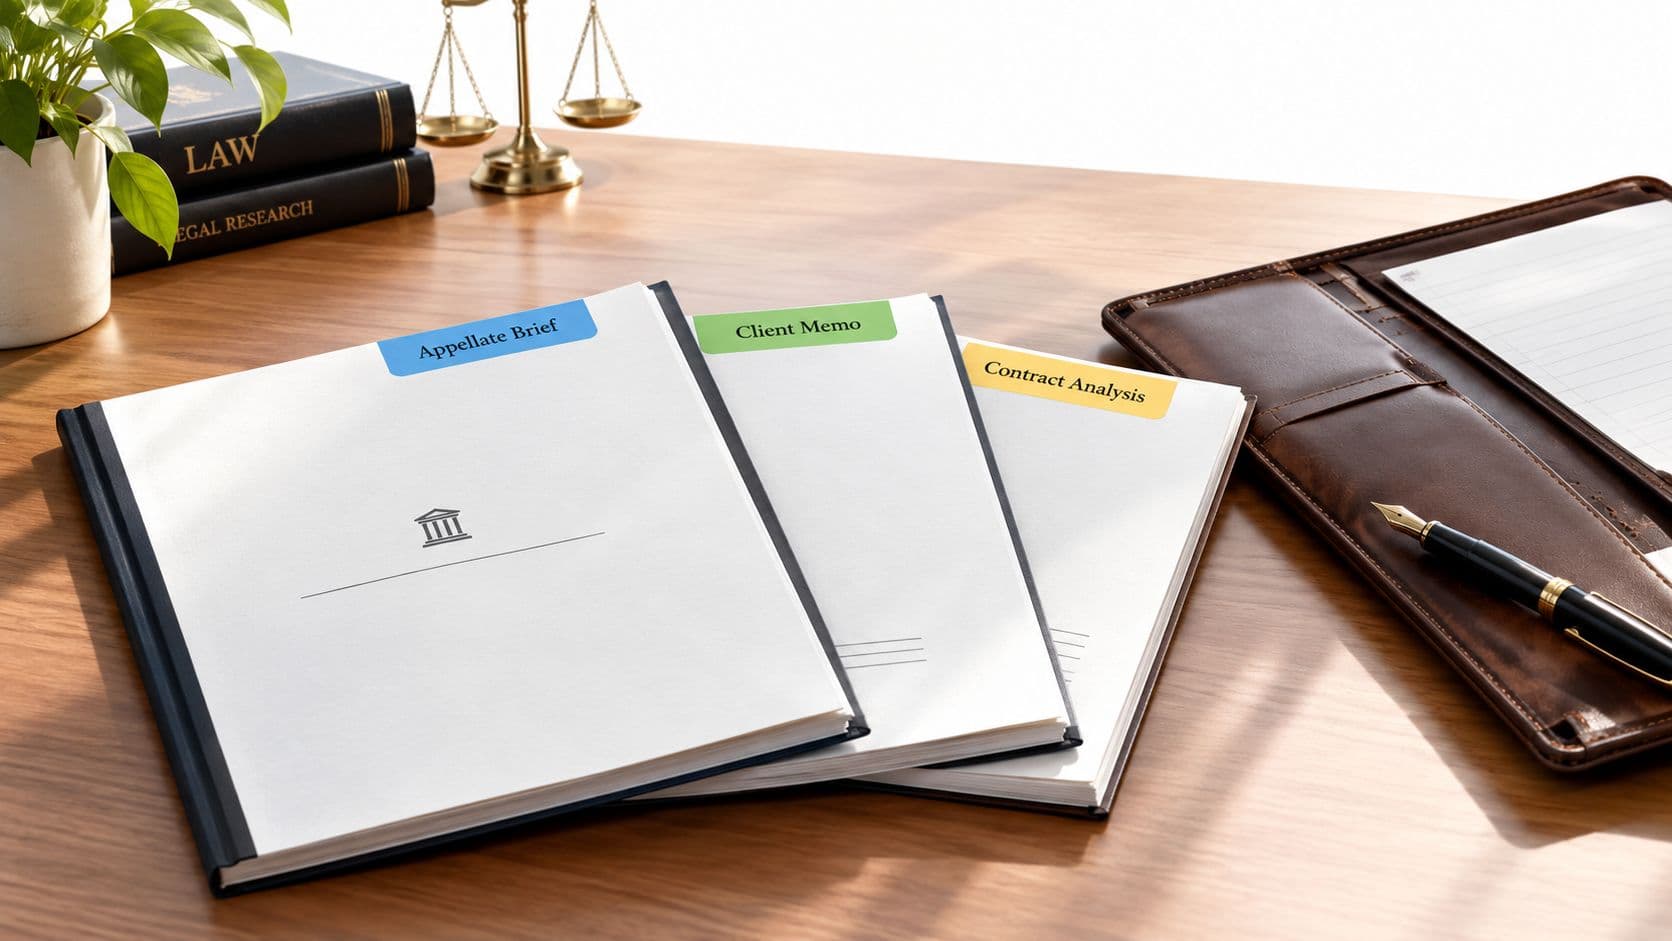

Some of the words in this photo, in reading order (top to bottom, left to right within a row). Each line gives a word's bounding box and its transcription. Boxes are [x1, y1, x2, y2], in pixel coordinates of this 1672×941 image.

[184, 133, 260, 174] LAW
[167, 220, 221, 243] EGAL
[225, 200, 313, 231] RESEARCH
[419, 332, 507, 360] Appellate
[510, 318, 558, 340] Brief
[736, 324, 795, 339] Client
[800, 319, 861, 334] Memo
[984, 361, 1065, 388] Contract
[1068, 377, 1146, 403] Analysis
